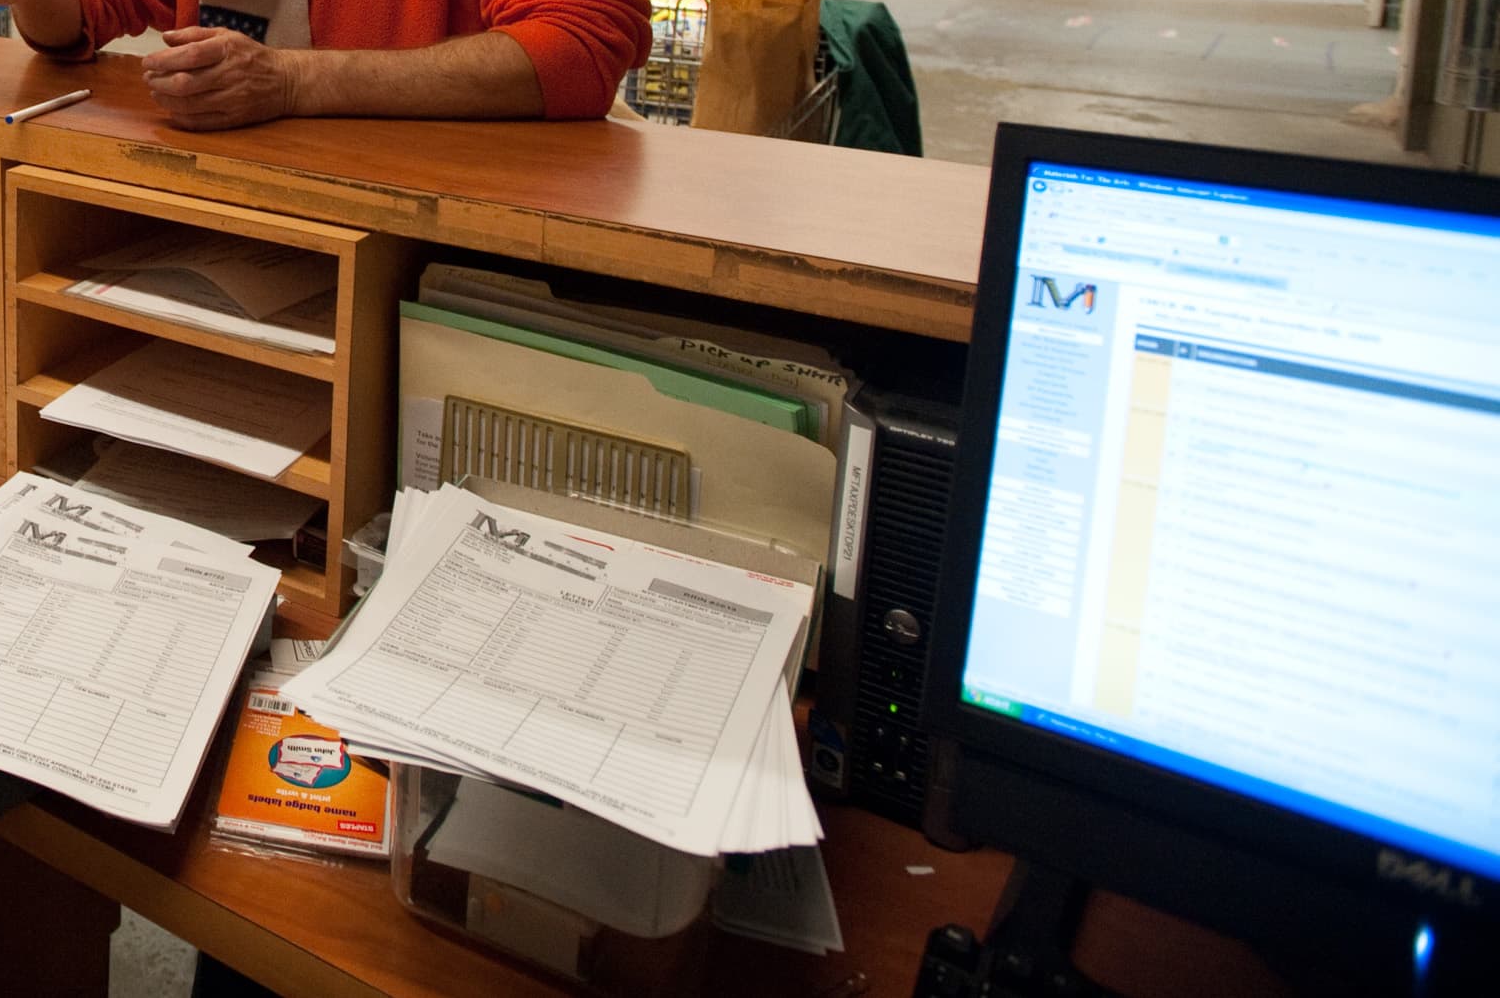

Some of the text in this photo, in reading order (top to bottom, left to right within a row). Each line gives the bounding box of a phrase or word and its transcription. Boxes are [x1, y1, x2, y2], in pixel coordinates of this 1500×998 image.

[287, 745, 336, 756] John Smith
[276, 788, 331, 802] print & write
[248, 793, 357, 818] name badge labels
[339, 821, 374, 833] STAPLES
